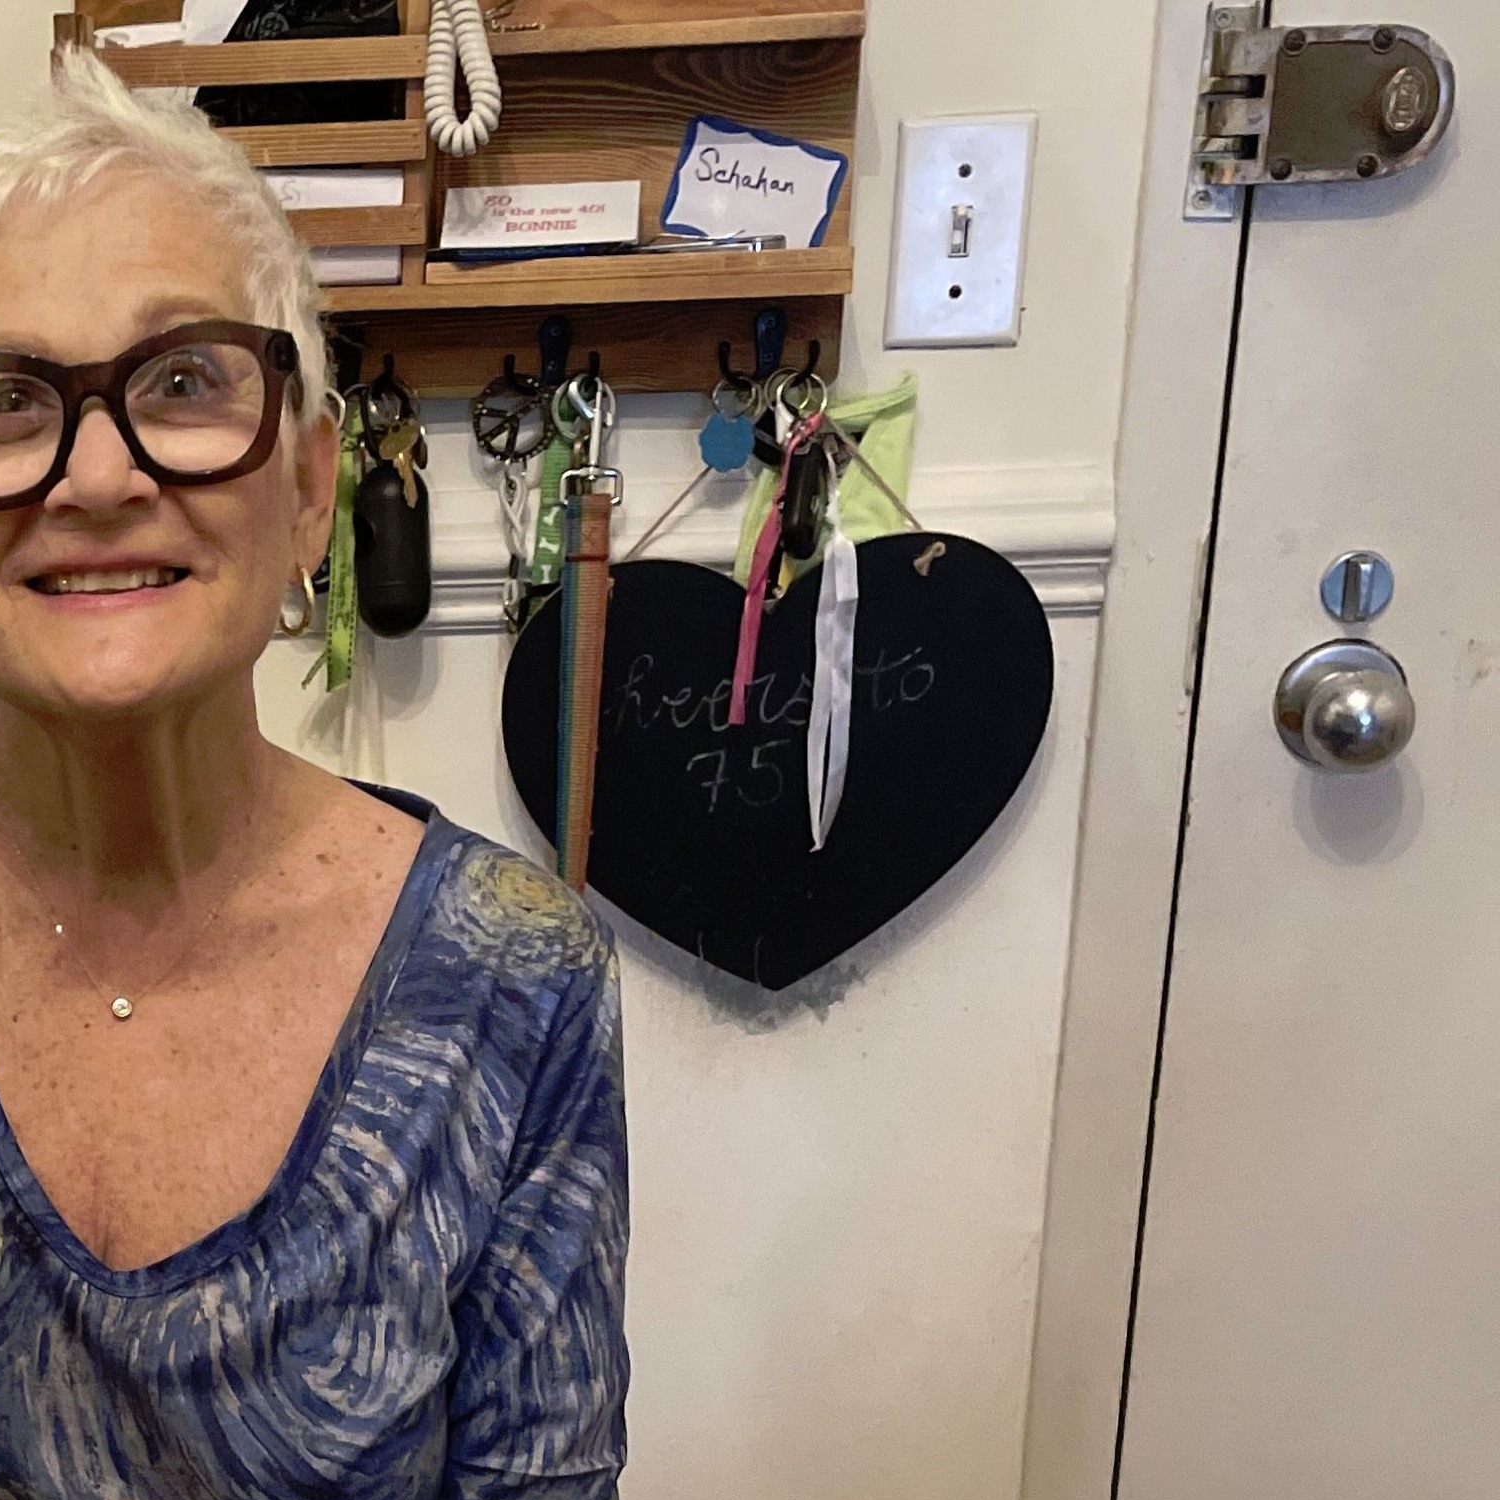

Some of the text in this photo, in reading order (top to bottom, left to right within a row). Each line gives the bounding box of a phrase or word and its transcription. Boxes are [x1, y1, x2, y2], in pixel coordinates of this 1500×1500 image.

[510, 207, 535, 216] the
[540, 206, 572, 215] new
[505, 219, 577, 233] BONNIE
[686, 740, 791, 813] 75
